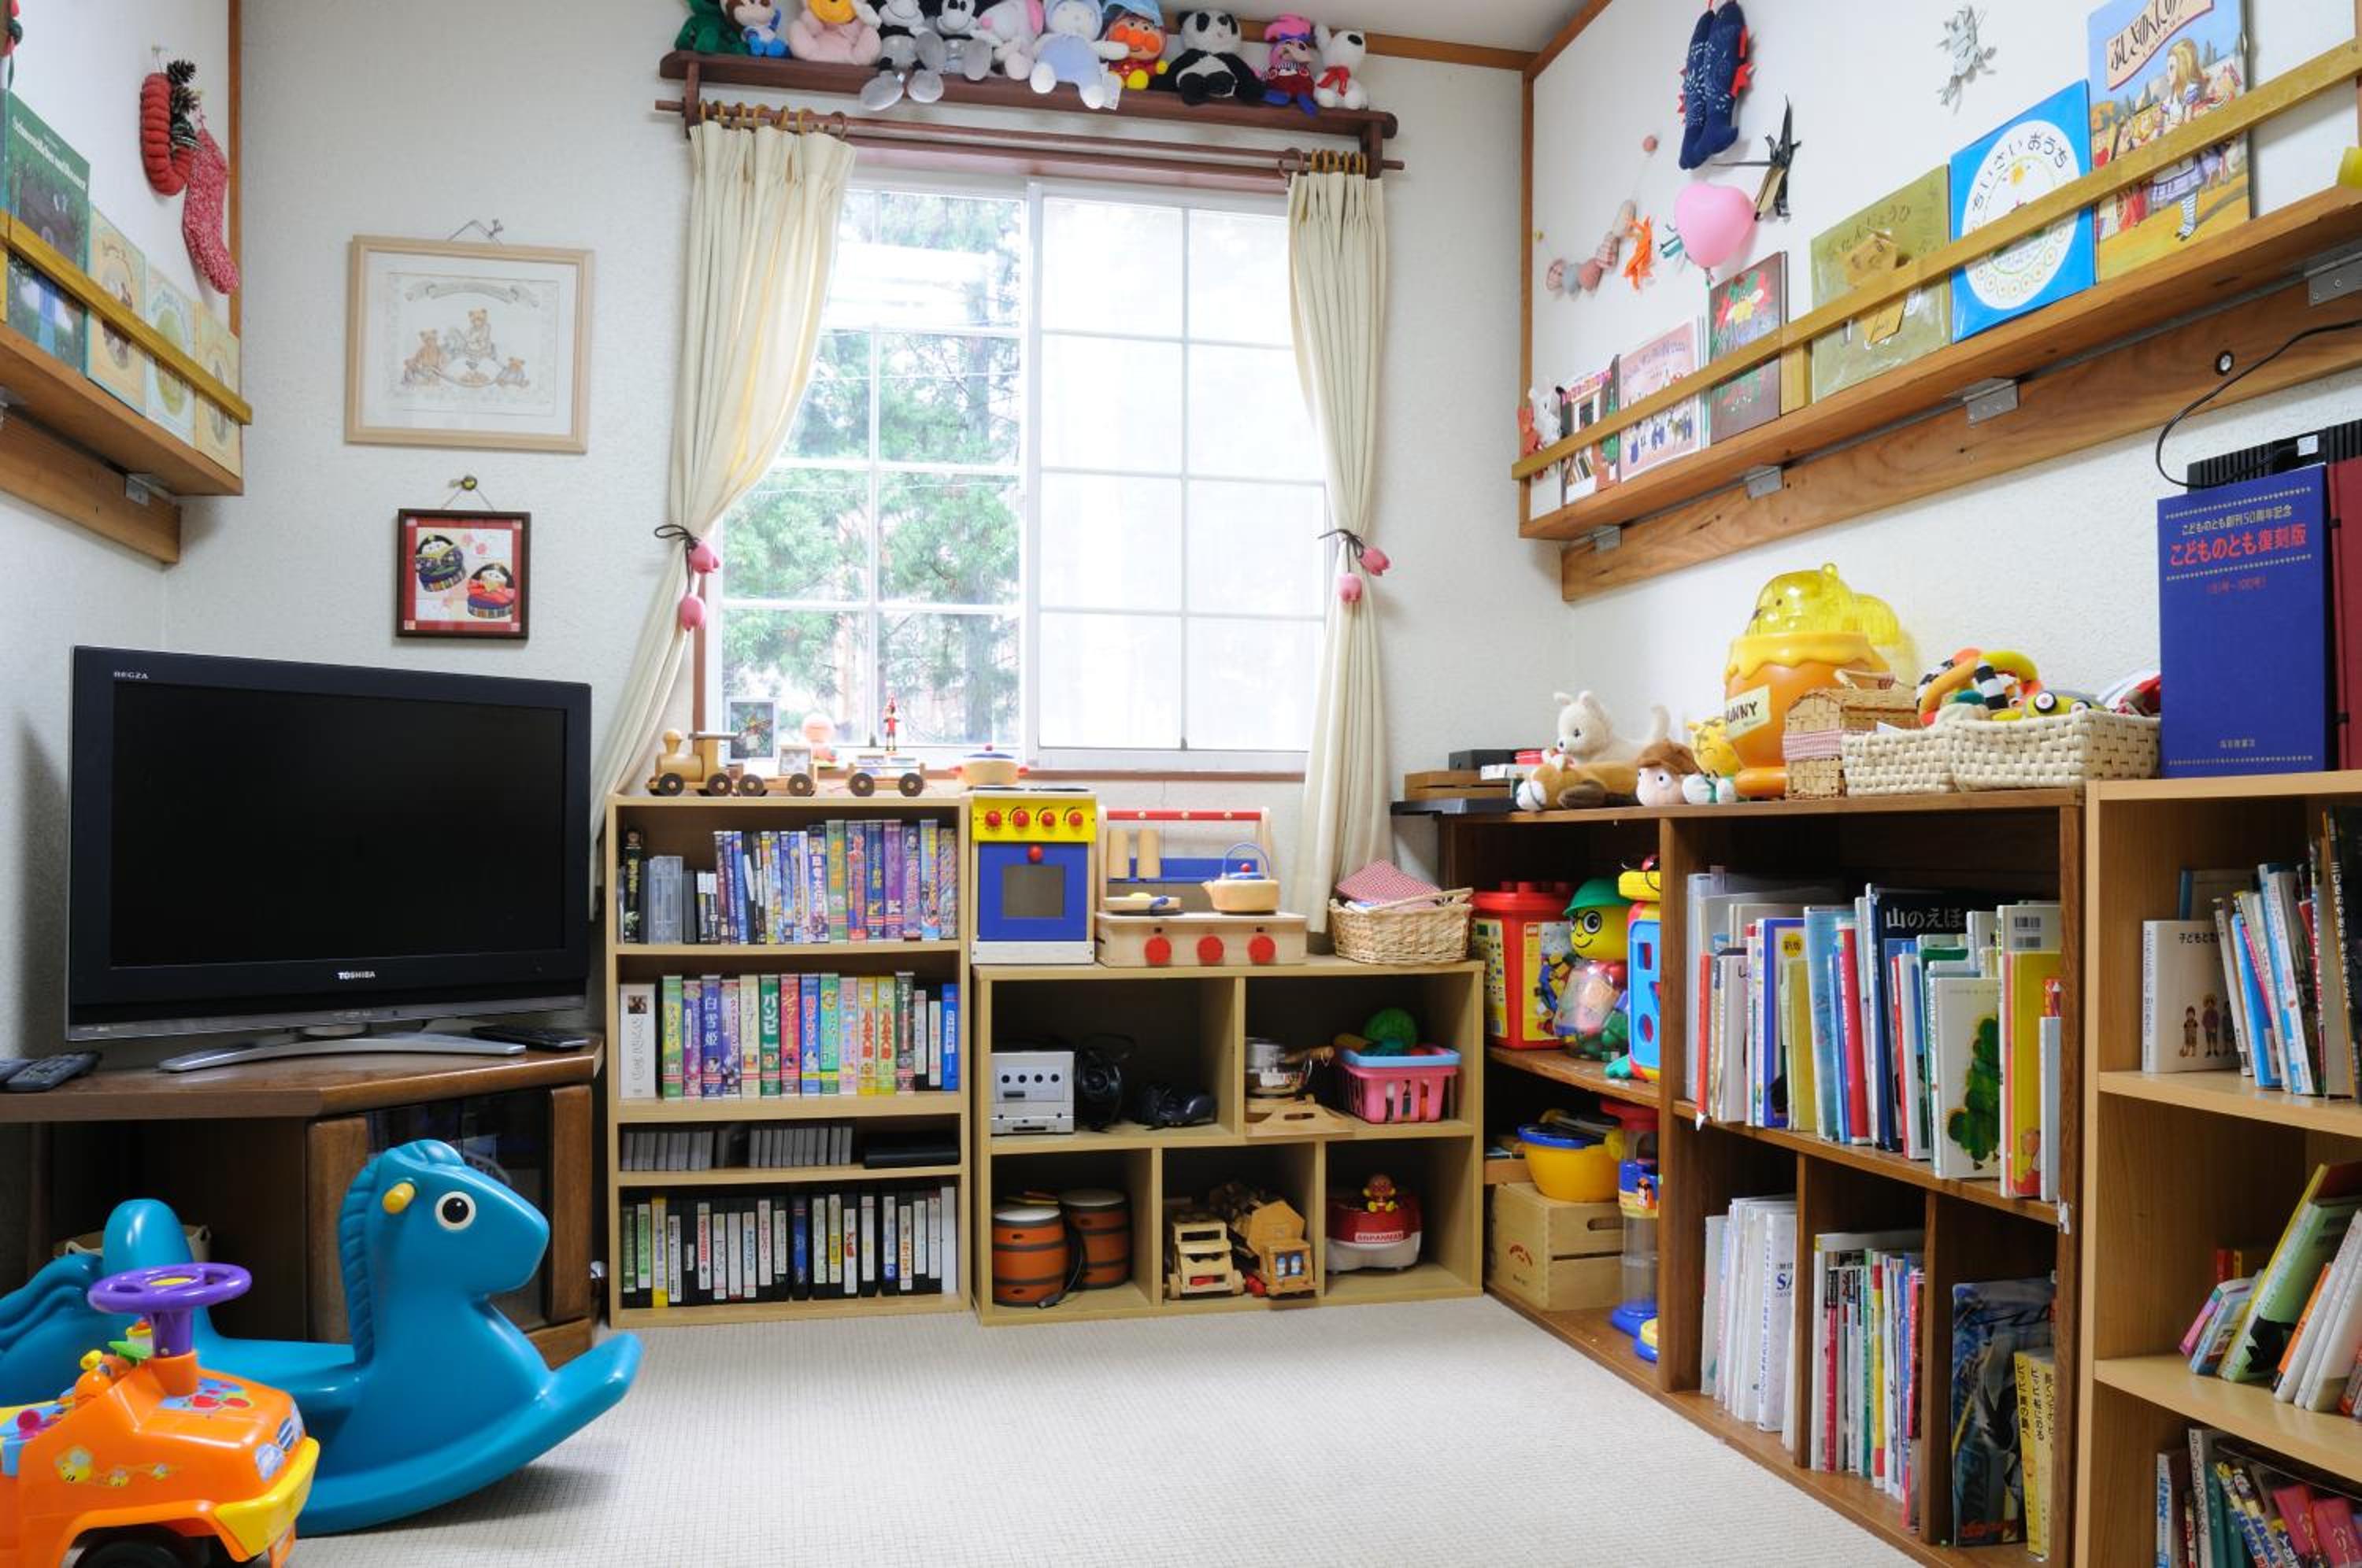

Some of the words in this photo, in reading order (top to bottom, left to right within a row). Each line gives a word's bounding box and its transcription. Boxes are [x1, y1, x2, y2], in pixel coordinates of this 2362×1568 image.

[2170, 523, 2306, 566] こどものとも復刻版
[1885, 907, 1965, 930] 山のえほ
[337, 971, 376, 980] TOSHIBA
[705, 995, 719, 1046] 白雪姫
[763, 992, 779, 1036] バンビ
